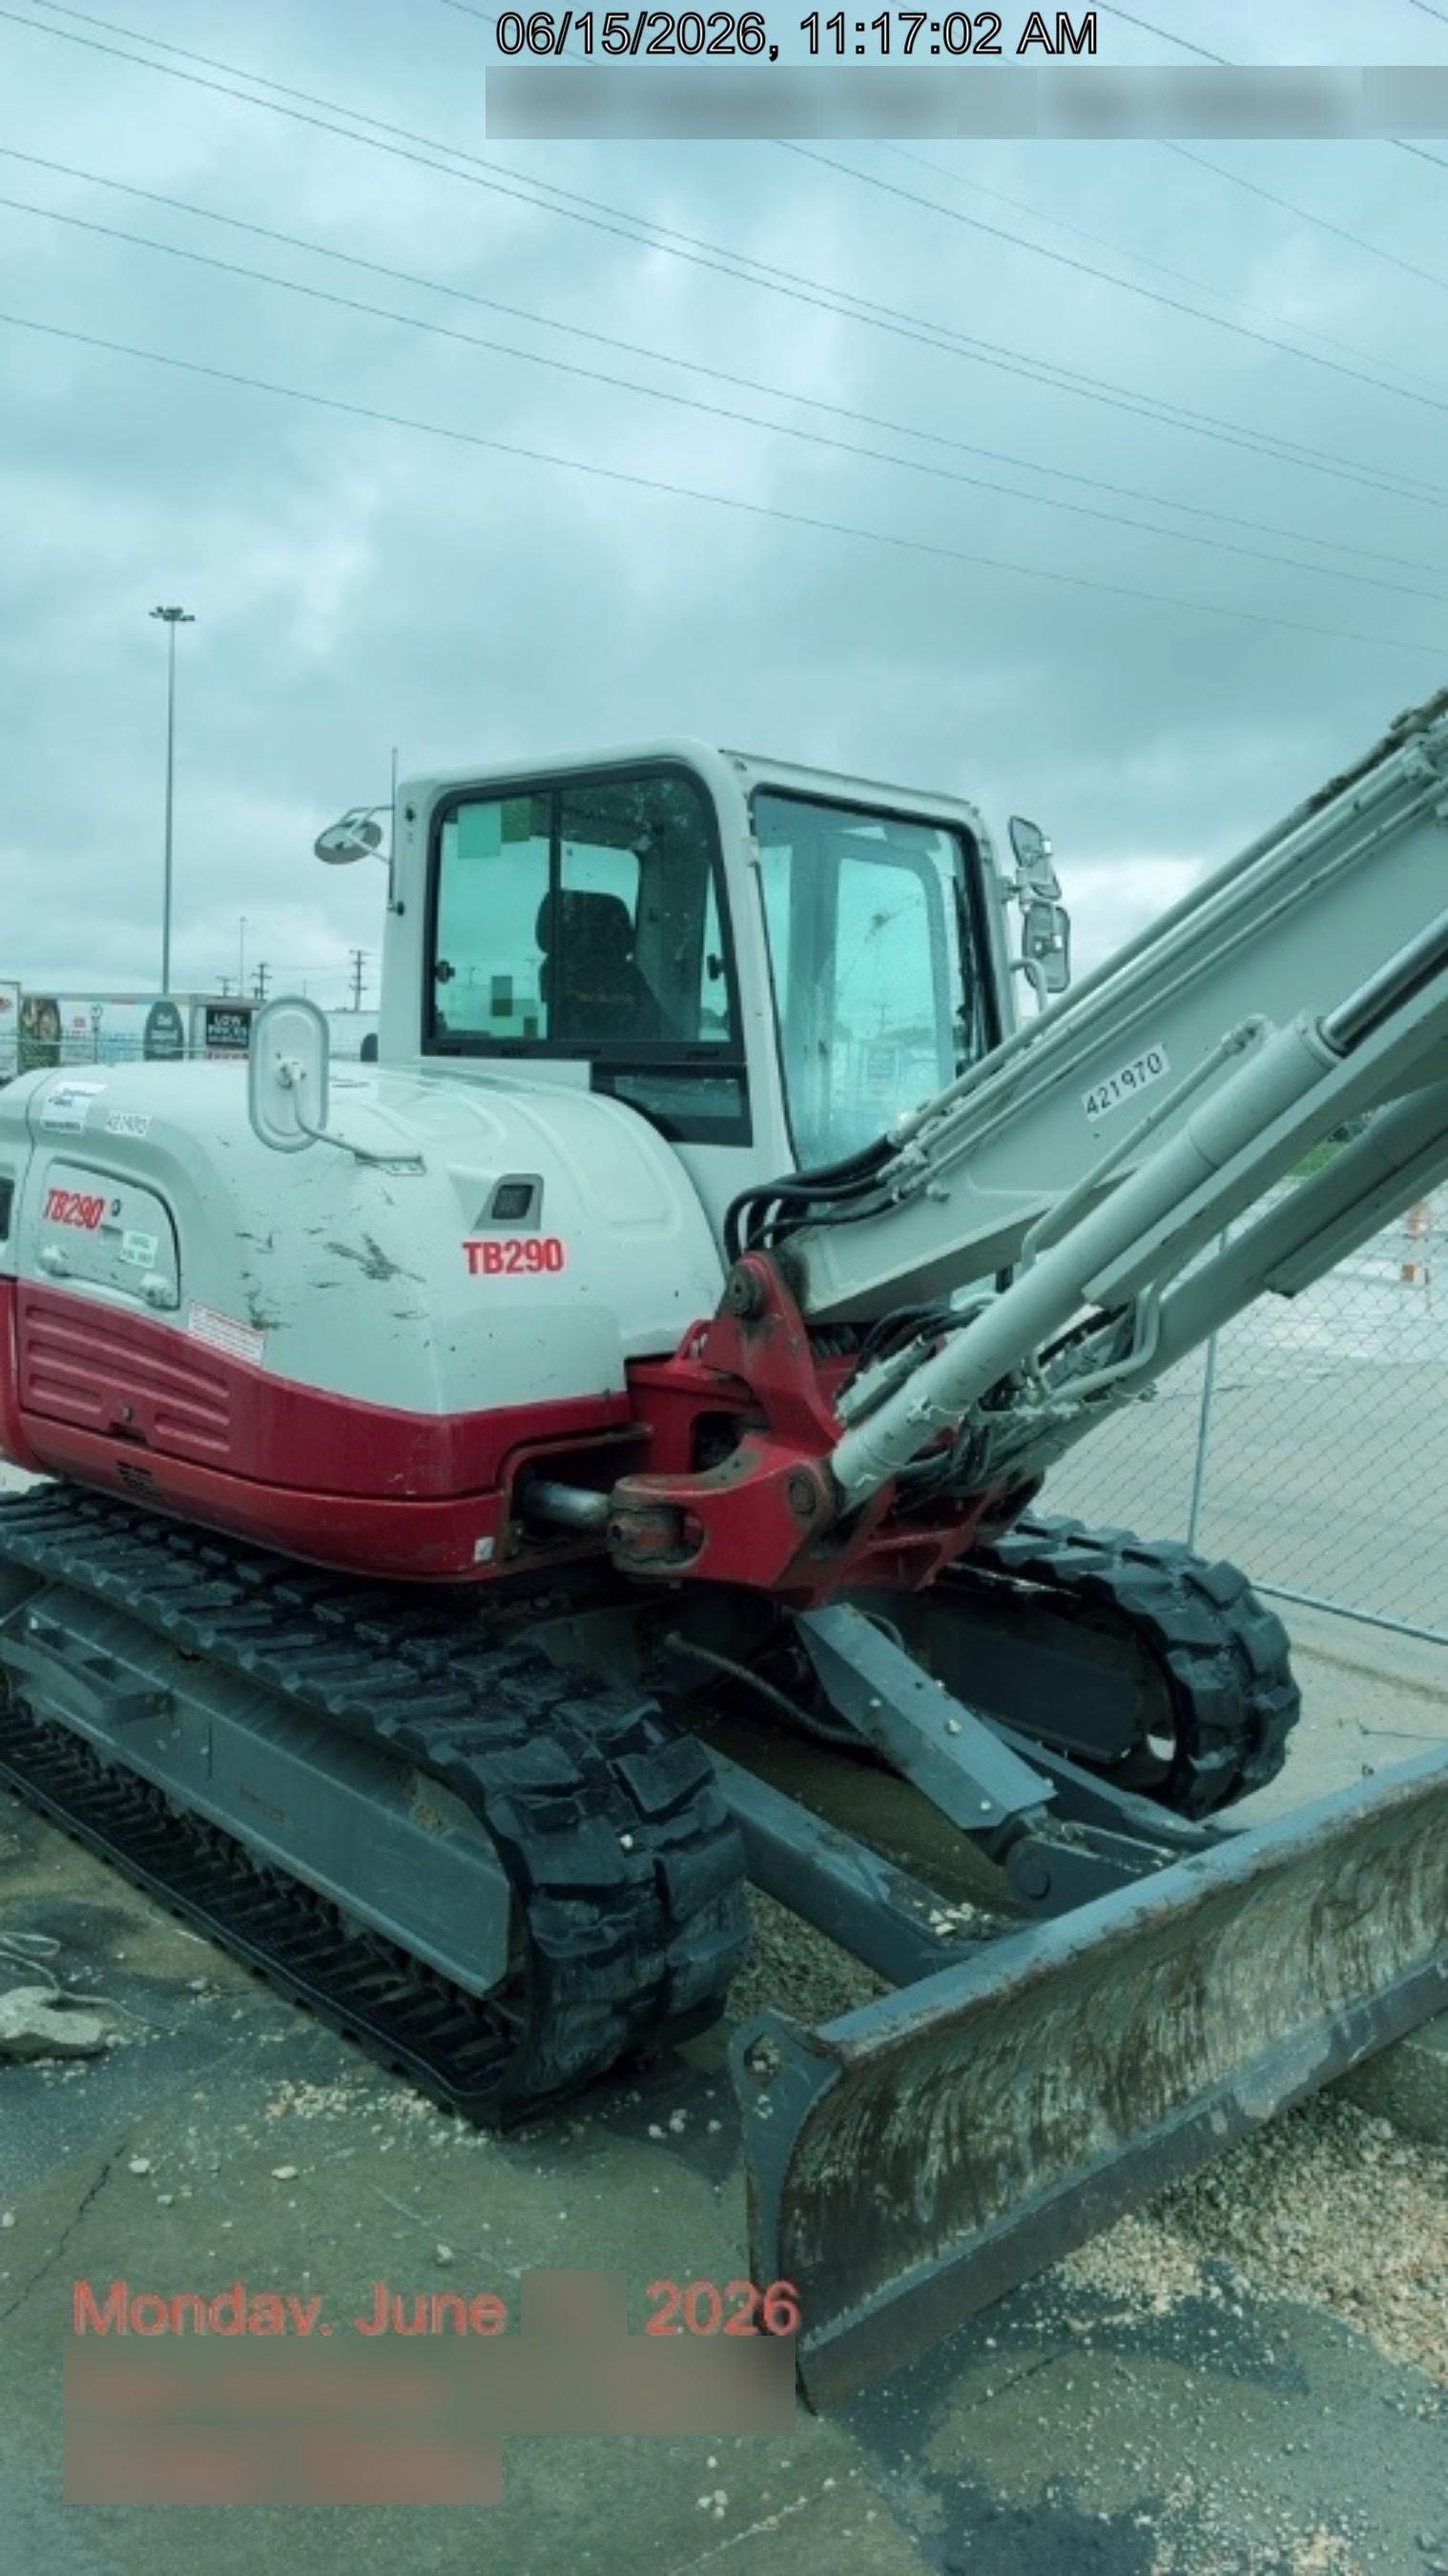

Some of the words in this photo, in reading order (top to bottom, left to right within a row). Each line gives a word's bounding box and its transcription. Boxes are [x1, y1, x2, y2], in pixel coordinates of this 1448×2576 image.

[1086, 1052, 1163, 1115] 421970
[43, 1189, 105, 1230] TB290
[462, 1237, 565, 1275] TB290
